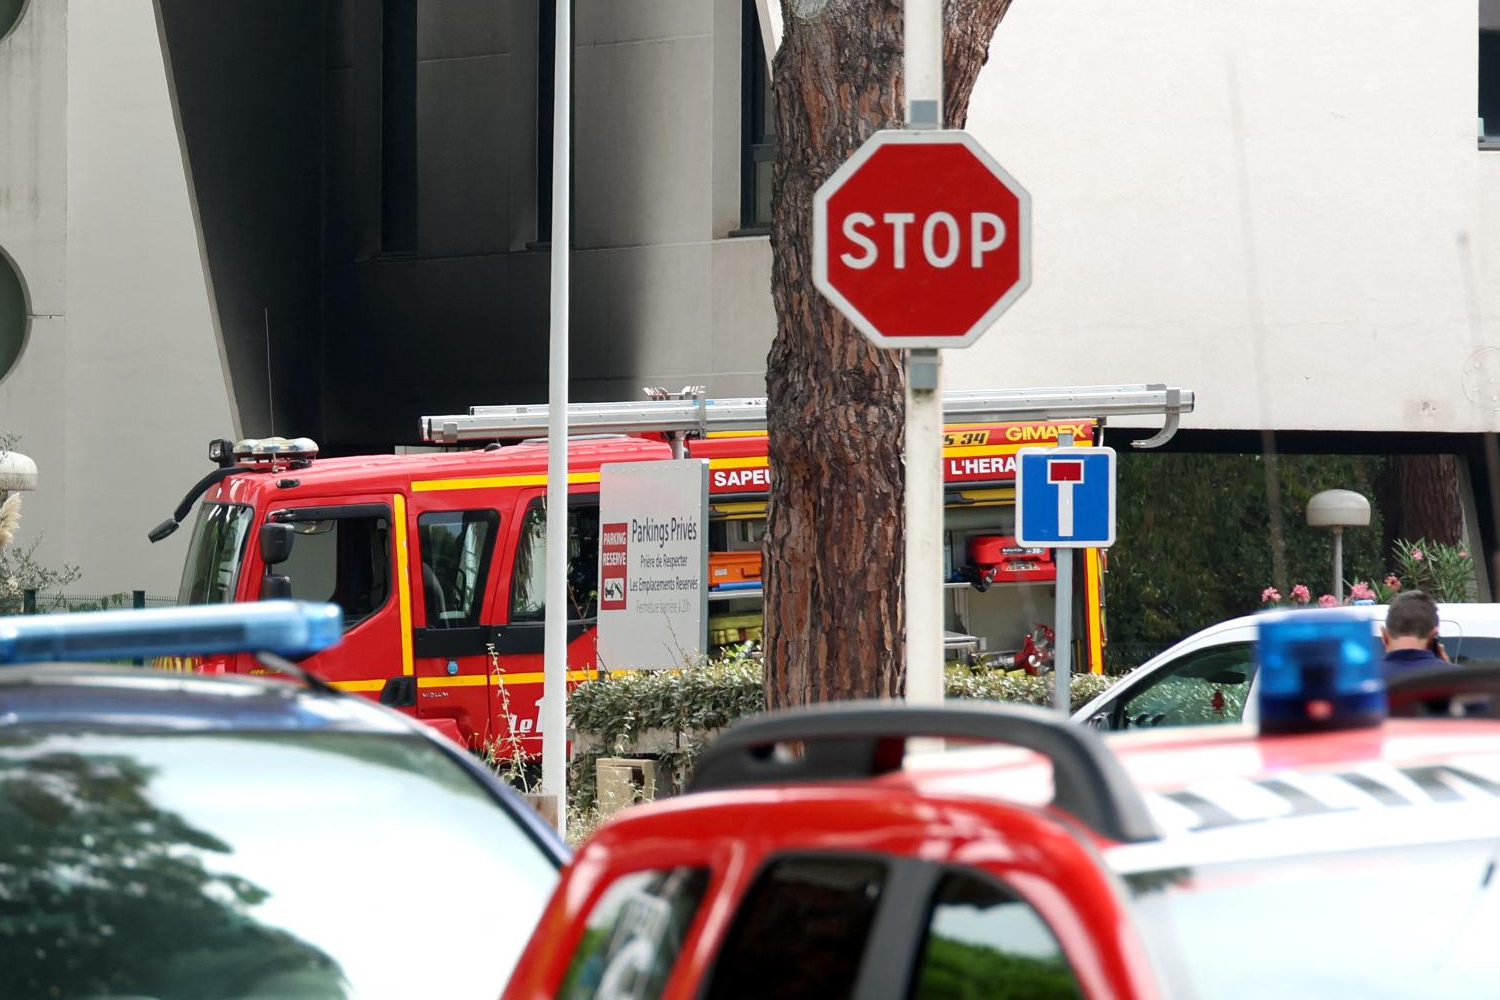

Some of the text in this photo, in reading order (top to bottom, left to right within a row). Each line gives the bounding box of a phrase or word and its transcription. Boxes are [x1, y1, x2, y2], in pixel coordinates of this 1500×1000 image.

[840, 211, 1006, 270] STOP
[961, 432, 987, 445] 34
[603, 532, 626, 545] PARKING
[632, 516, 697, 548] Parkings Privés
[656, 553, 662, 568] de
[663, 553, 688, 570] Respecter
[629, 577, 638, 592] Les
[639, 576, 675, 596] Emplacements
